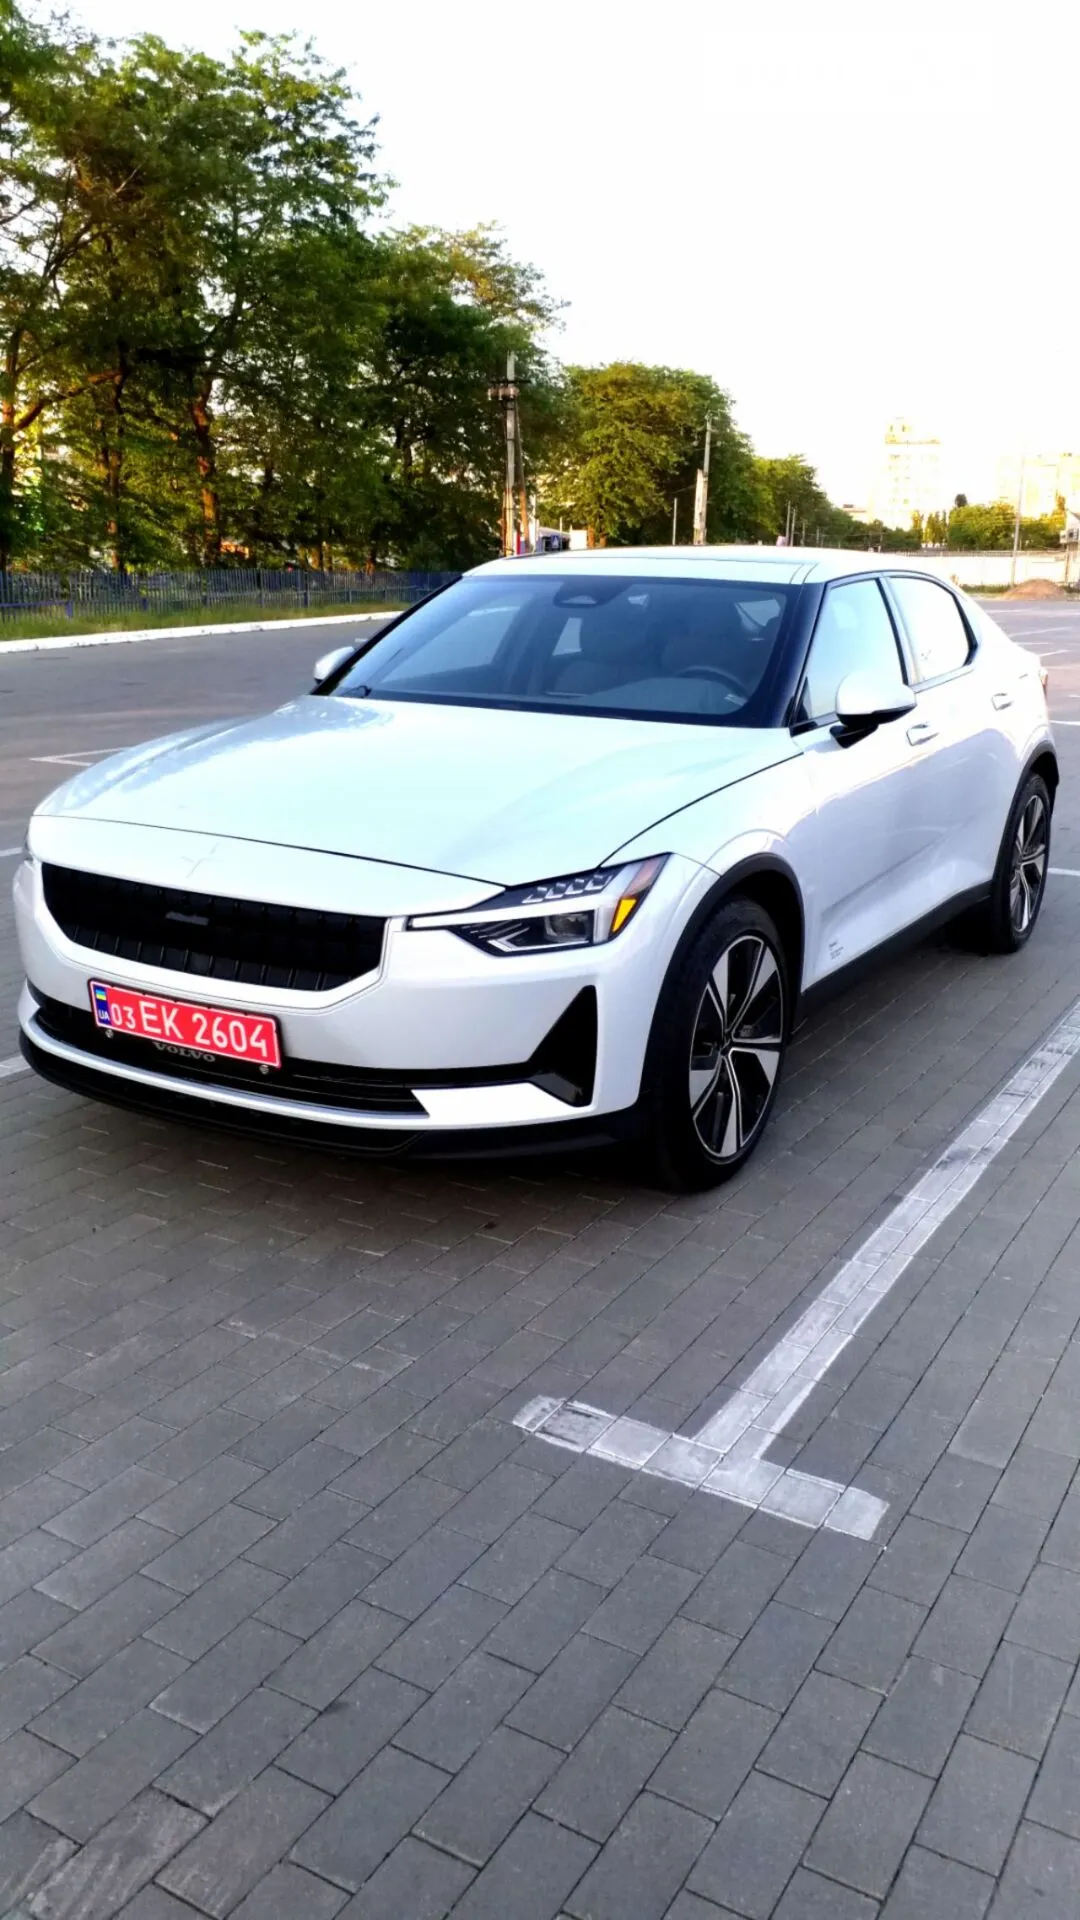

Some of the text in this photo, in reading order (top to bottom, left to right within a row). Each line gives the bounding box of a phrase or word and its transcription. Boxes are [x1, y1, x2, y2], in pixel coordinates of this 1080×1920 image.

[98, 1009, 110, 1021] UA
[110, 1001, 268, 1057] 03 EK 2604
[153, 1042, 216, 1062] VOLVO
